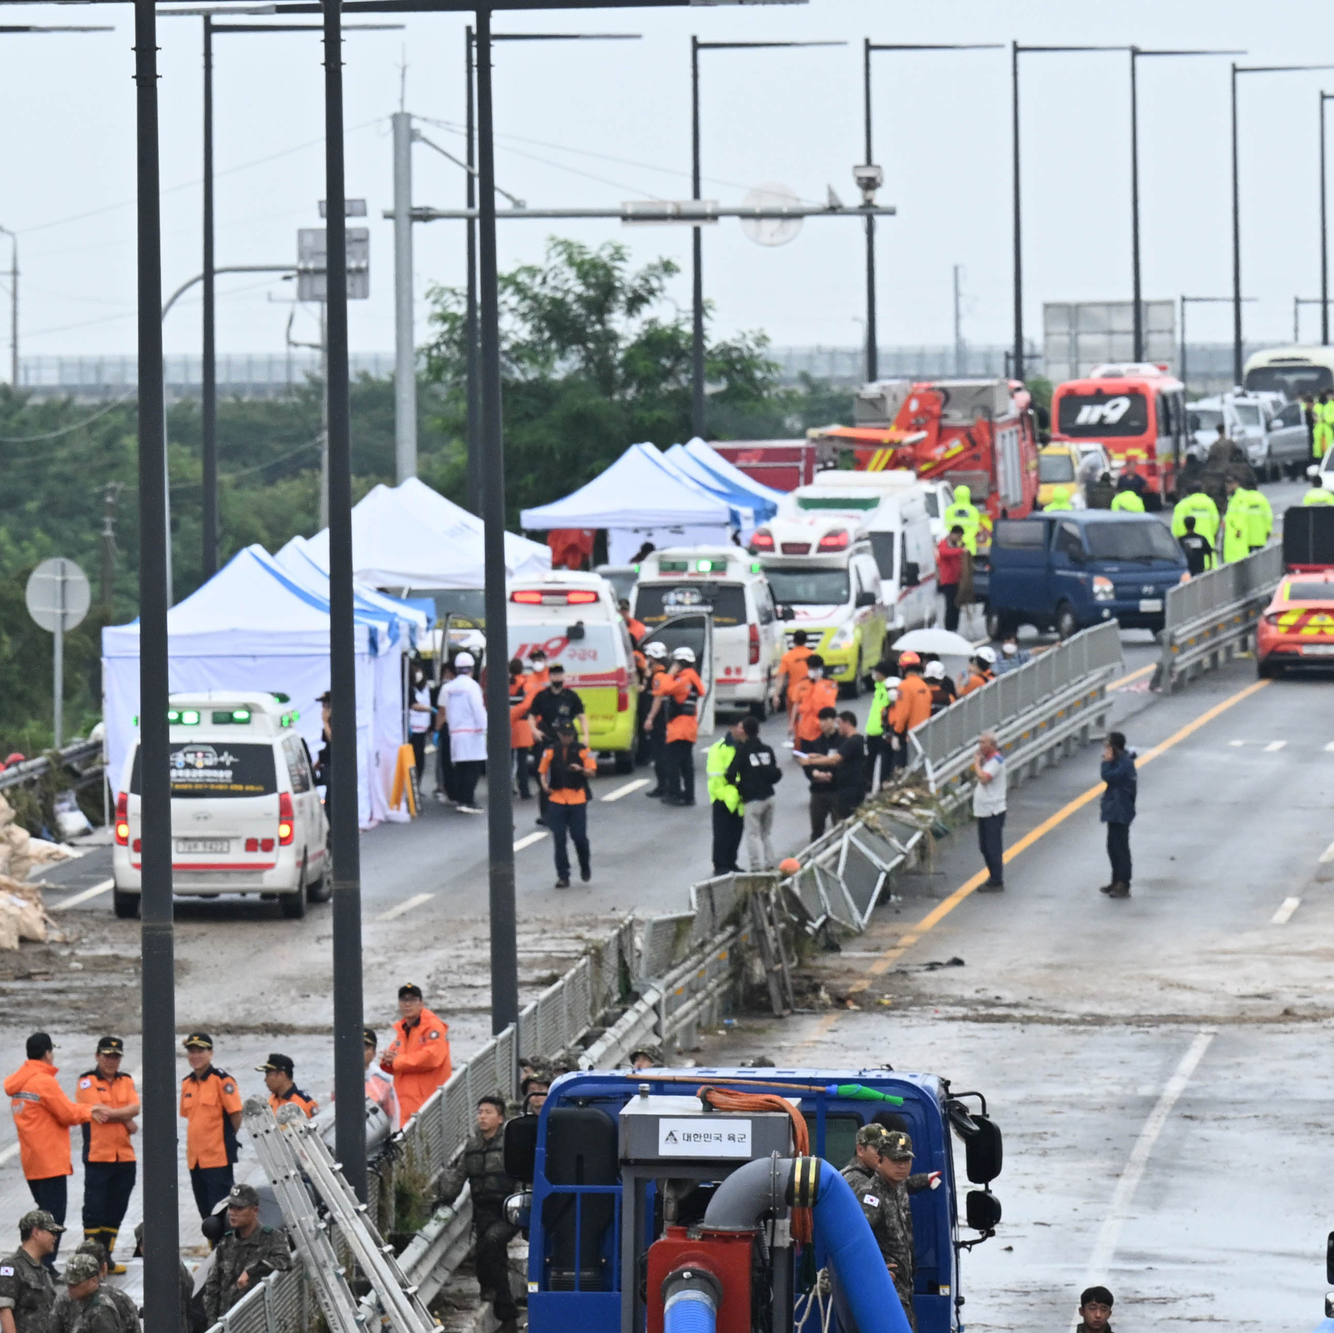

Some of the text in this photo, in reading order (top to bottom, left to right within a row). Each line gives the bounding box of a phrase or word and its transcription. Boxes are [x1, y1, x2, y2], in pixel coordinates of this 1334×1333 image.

[1075, 396, 1131, 426] 119
[682, 1132, 747, 1144] 대한민국 육군
